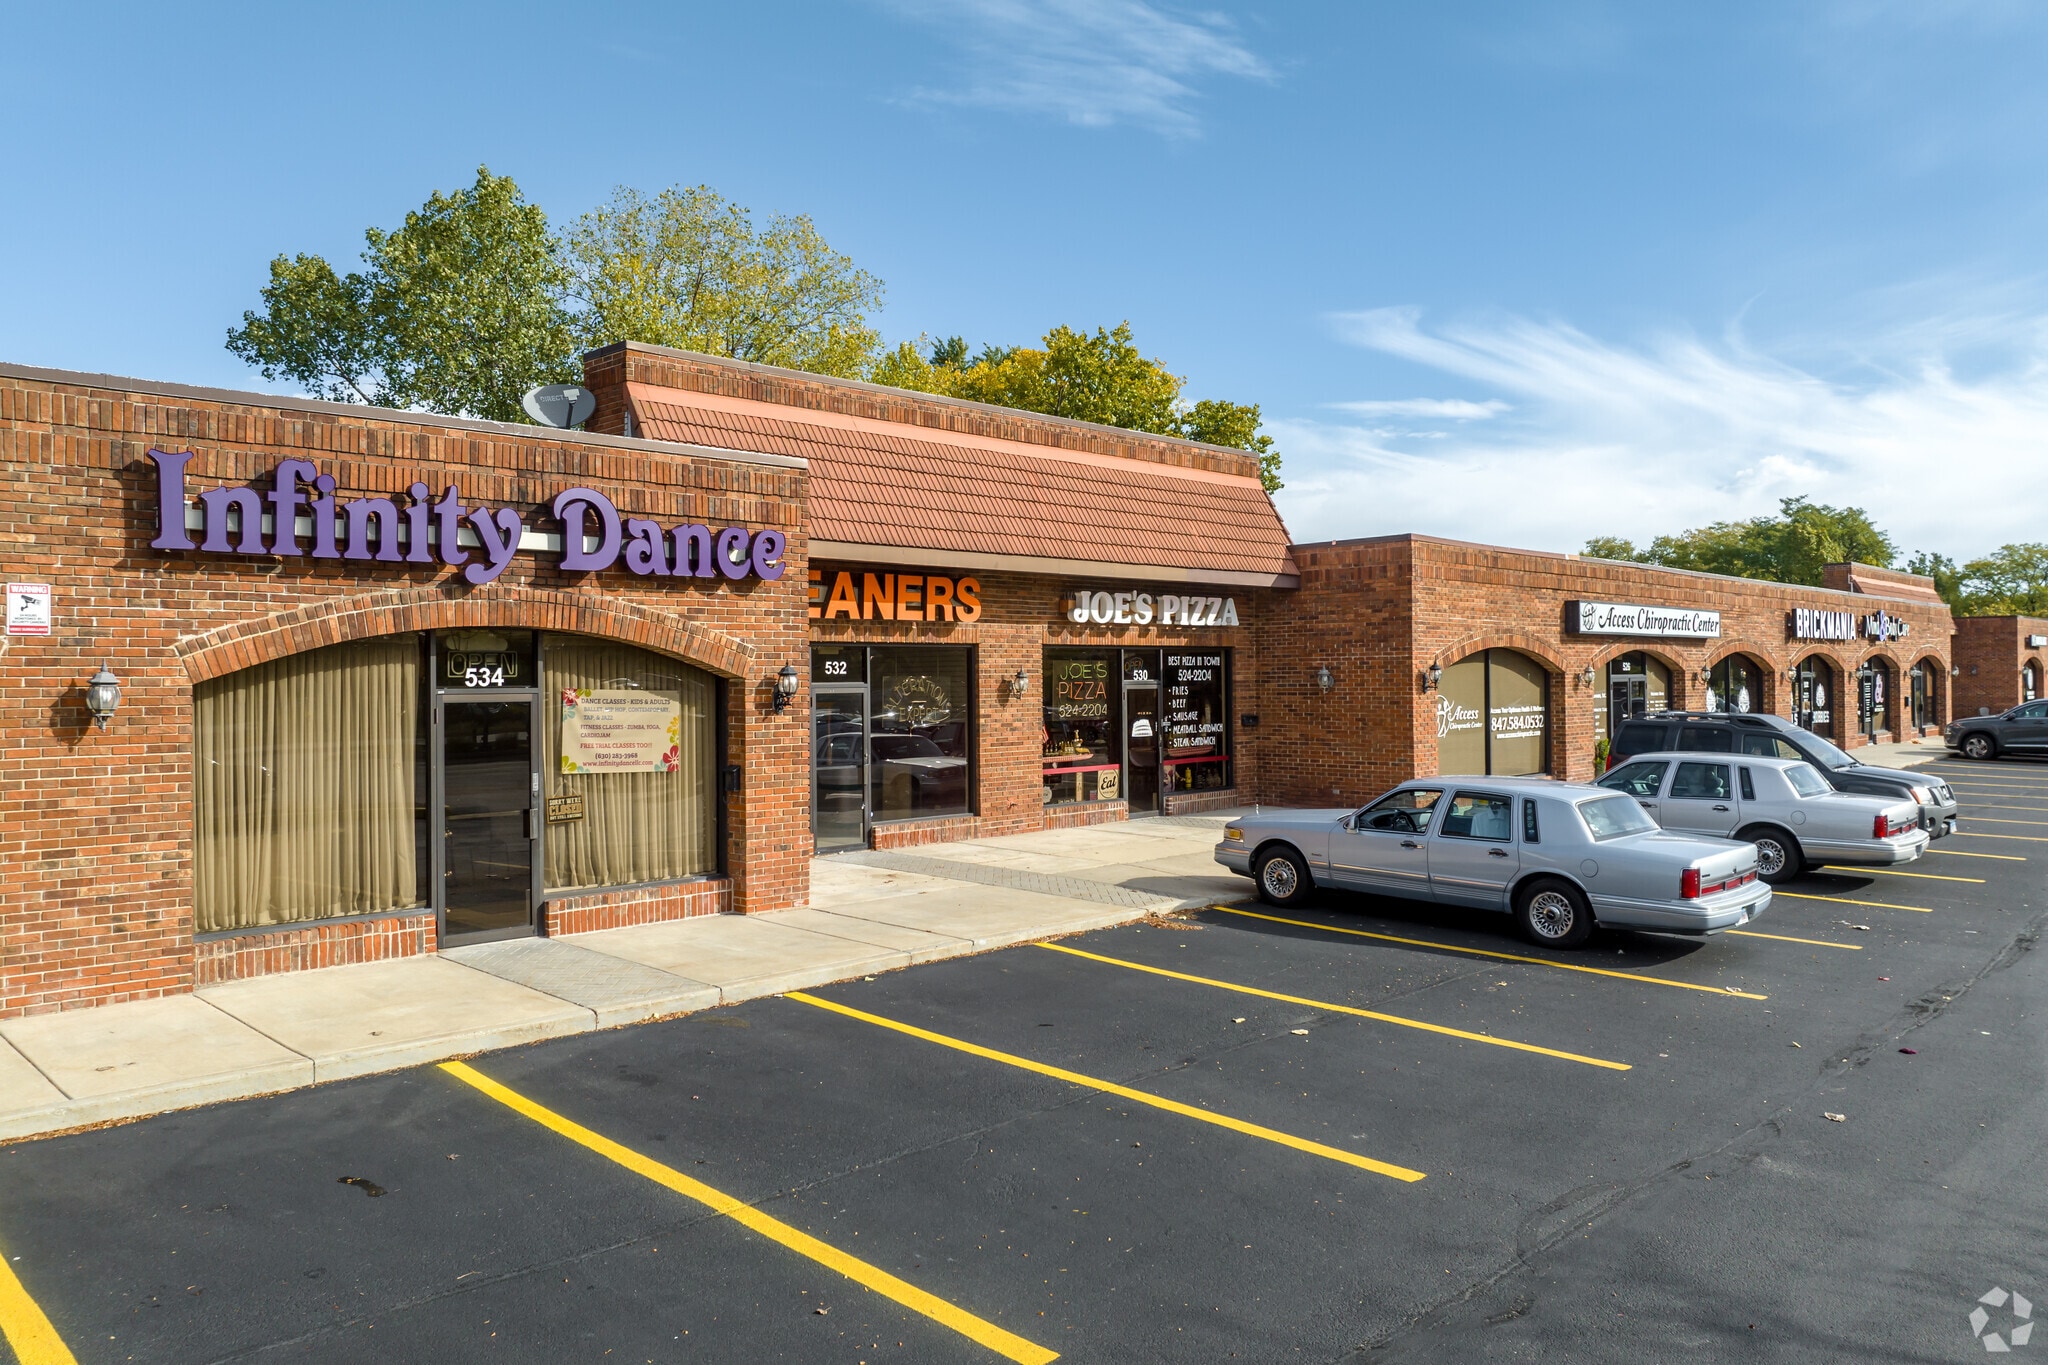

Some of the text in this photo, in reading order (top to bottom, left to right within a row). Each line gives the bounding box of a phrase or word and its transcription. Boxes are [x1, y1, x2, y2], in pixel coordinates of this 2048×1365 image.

[147, 448, 786, 585] Infinity Dance
[10, 585, 47, 594] WARNING
[1072, 590, 1239, 626] JOE'S PIZZA
[1598, 607, 1719, 634] Access Chiropractic Center
[1796, 607, 1856, 640] BRICKMANIA
[824, 661, 847, 675] 532
[1168, 656, 1180, 666] BEST
[1182, 656, 1196, 666] PIZZA
[1197, 656, 1202, 666] IN
[1622, 662, 1630, 671] 526
[464, 667, 505, 687] 534
[1059, 662, 1108, 680] JOE'S
[1133, 669, 1148, 681] 530
[1178, 669, 1212, 681] 524-2204
[1058, 681, 1108, 700] PIZZA
[1172, 686, 1188, 695] FRIES
[1058, 703, 1108, 718] 524-2204
[1172, 699, 1186, 708] BEEF
[1172, 711, 1198, 722] SAUSAGE
[1448, 705, 1479, 721] Access
[1172, 723, 1224, 734] MEATBALL SANDWICH
[1491, 714, 1545, 731] 847.584.0532
[1173, 736, 1216, 748] STEAK SANDWICH
[1101, 776, 1116, 790] Eat
[549, 803, 582, 816] CLOSED
